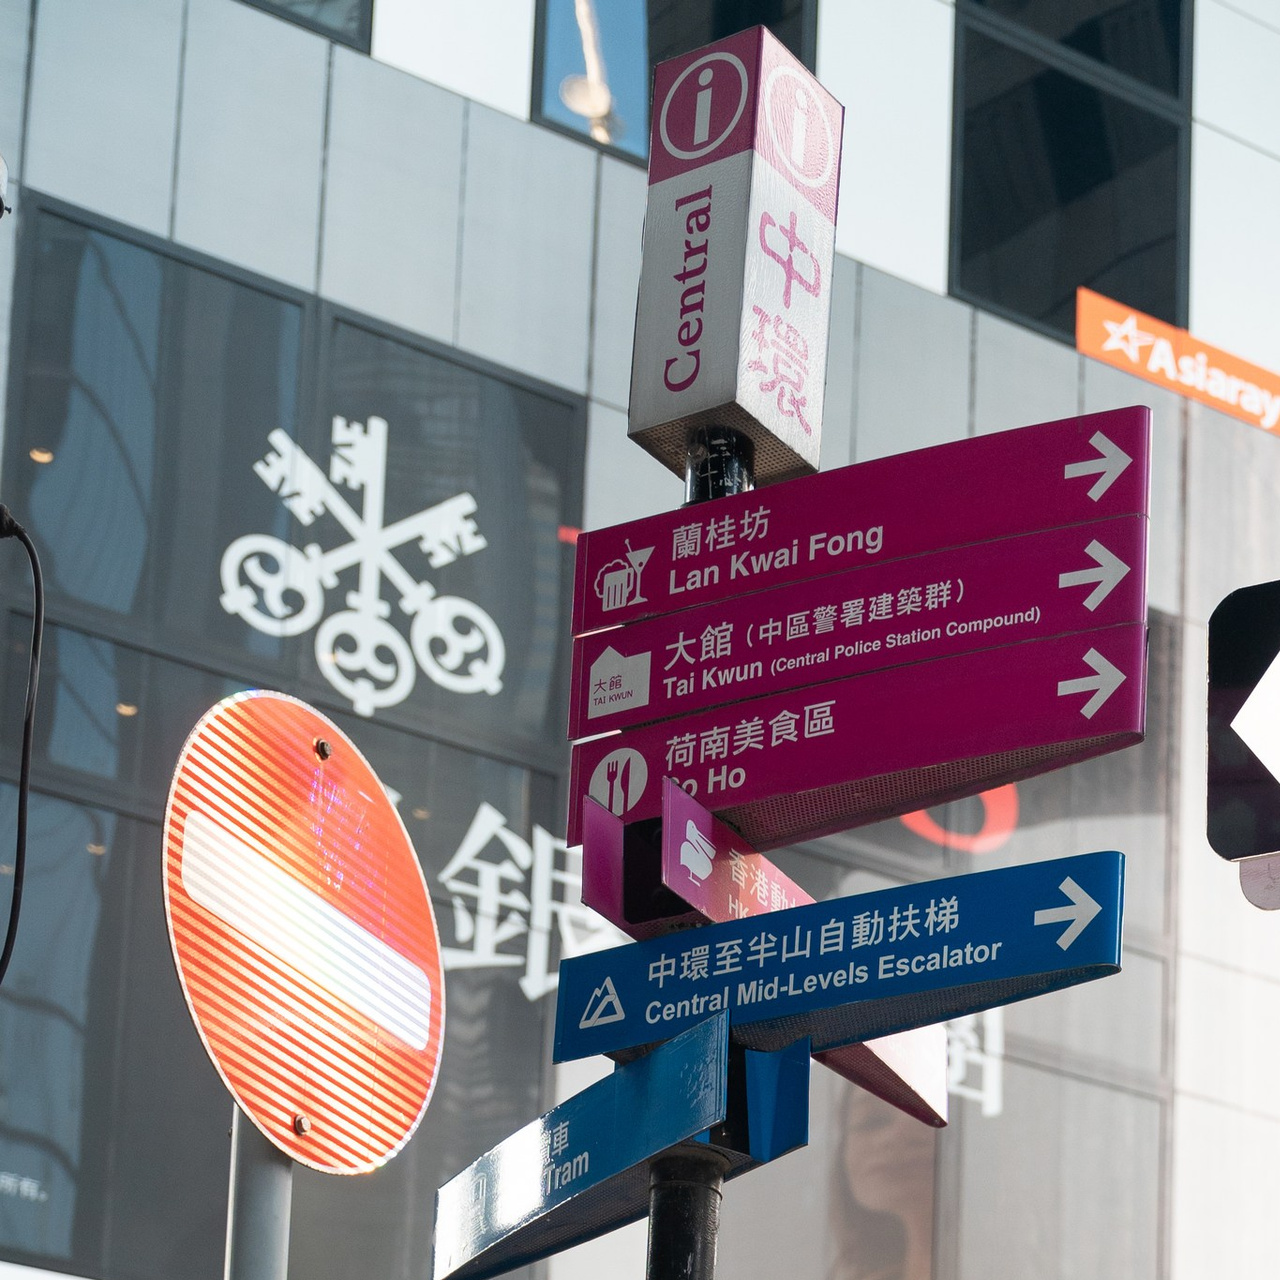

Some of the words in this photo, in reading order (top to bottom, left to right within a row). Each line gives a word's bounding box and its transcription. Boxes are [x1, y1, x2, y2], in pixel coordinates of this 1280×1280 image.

[663, 183, 714, 393] Central
[748, 211, 822, 437] 中環
[669, 566, 723, 595] Lan
[730, 541, 799, 580] Kwai
[809, 525, 884, 561] Fong
[672, 505, 771, 561] 蘭桂坊
[663, 621, 734, 673] 大館
[663, 672, 695, 699] Tai
[702, 661, 763, 690] Kwun
[770, 647, 830, 676] (Central
[834, 639, 882, 660] Police
[885, 627, 941, 649] Station
[945, 605, 1041, 637] Compound)
[594, 696, 606, 706] TAI
[608, 690, 633, 703] KWUN
[665, 699, 836, 771] 荷南美食區
[707, 764, 746, 794] Ho
[648, 895, 959, 988] 中環至半山自動扶梯
[645, 990, 729, 1025] Central
[737, 961, 869, 1006] Mid-Levels
[878, 942, 1003, 980] Escalator
[543, 1151, 590, 1195] Tram
